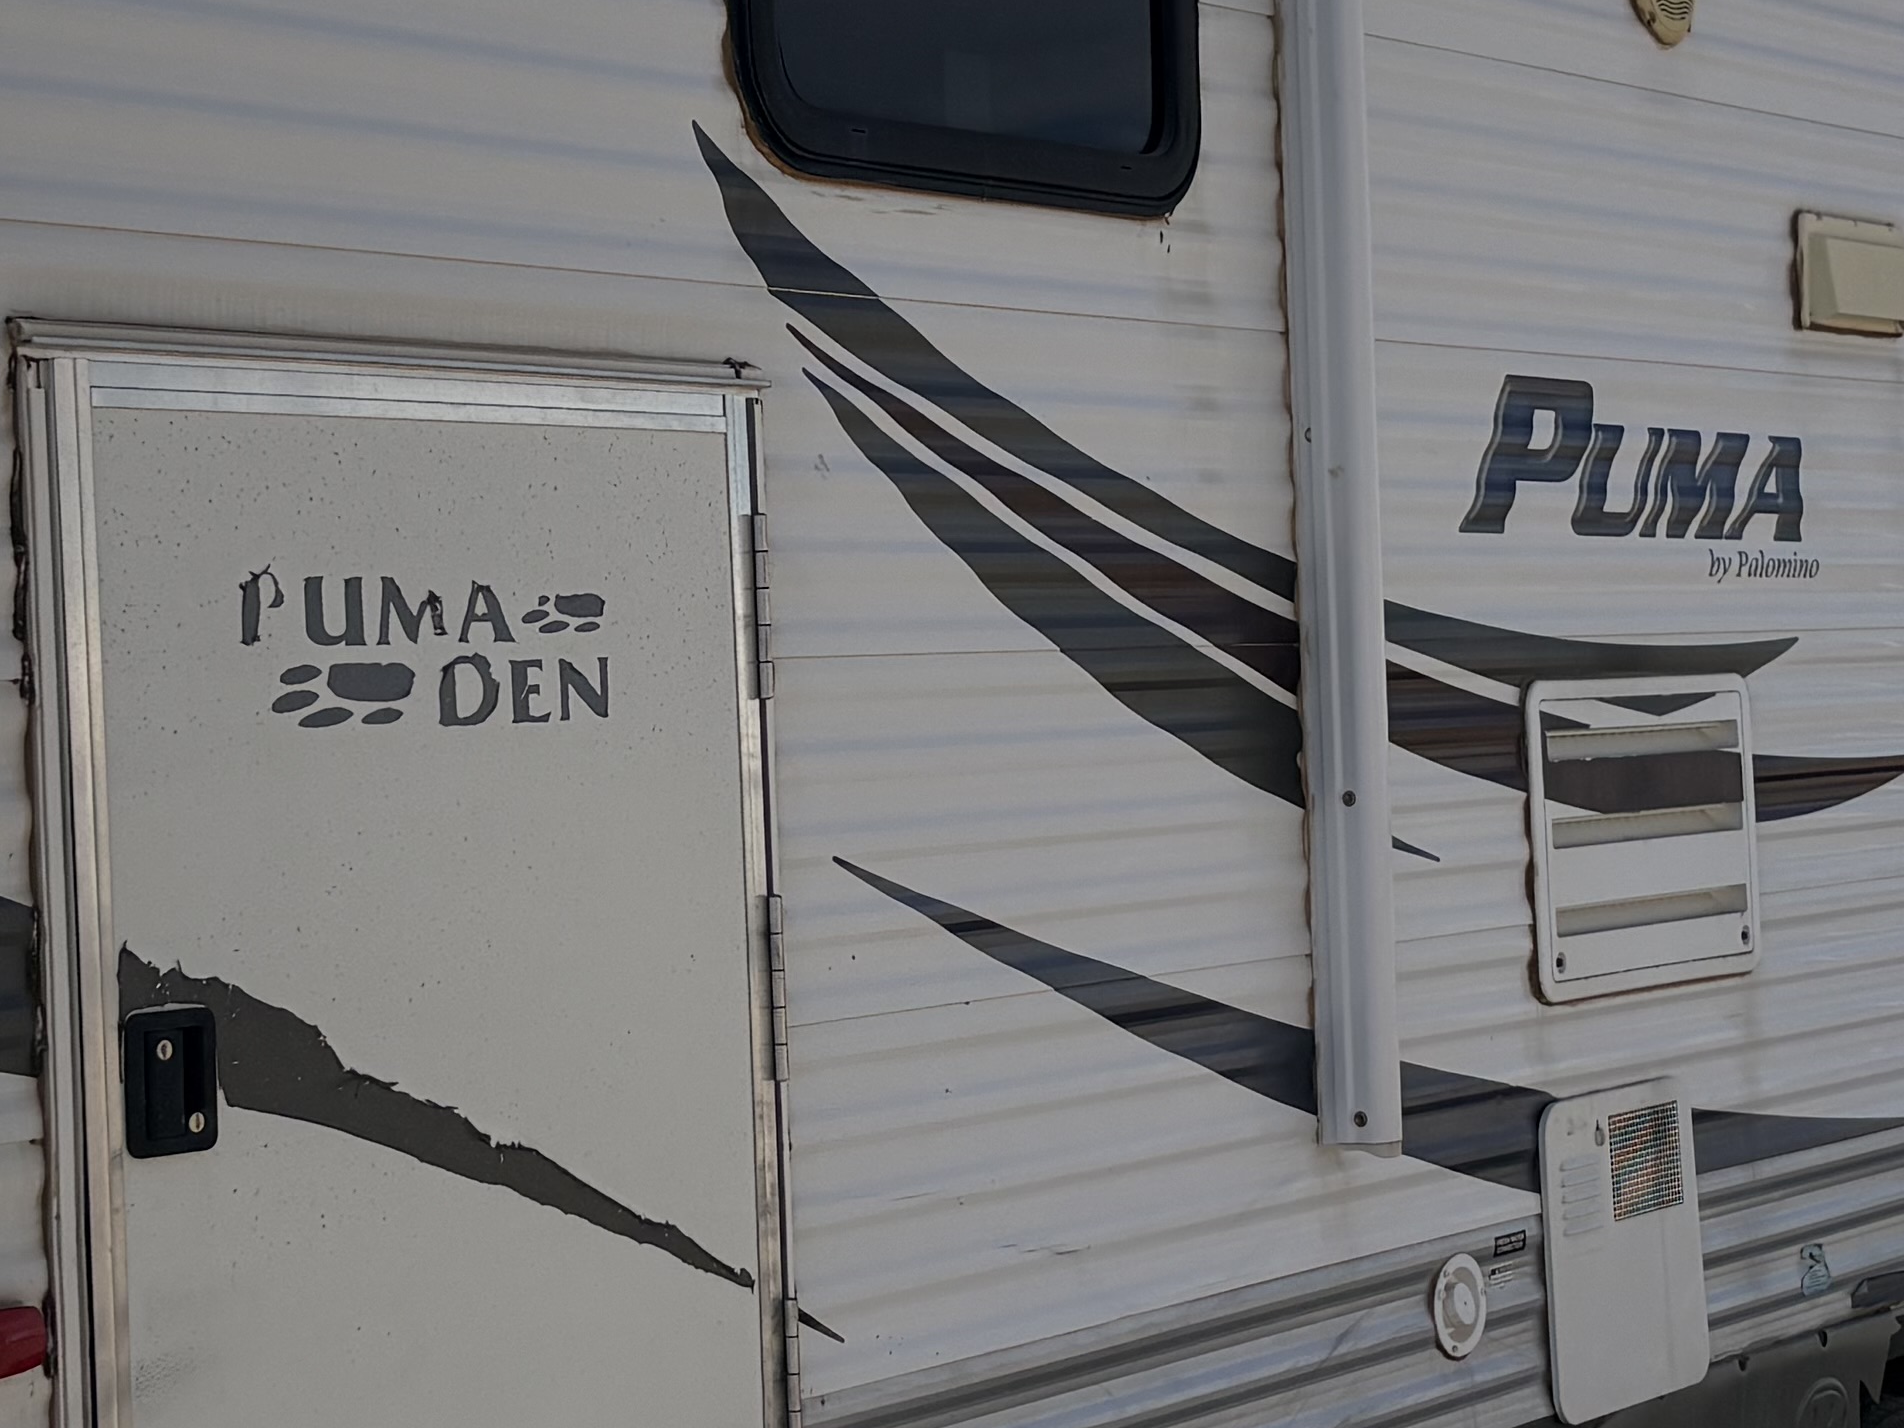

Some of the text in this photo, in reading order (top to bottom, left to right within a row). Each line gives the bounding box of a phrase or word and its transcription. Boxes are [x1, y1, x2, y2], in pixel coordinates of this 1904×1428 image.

[1458, 373, 1804, 542] PUMA
[239, 563, 517, 647] PUMA
[1708, 547, 1820, 584] by Palomino
[439, 651, 610, 727] DEN
